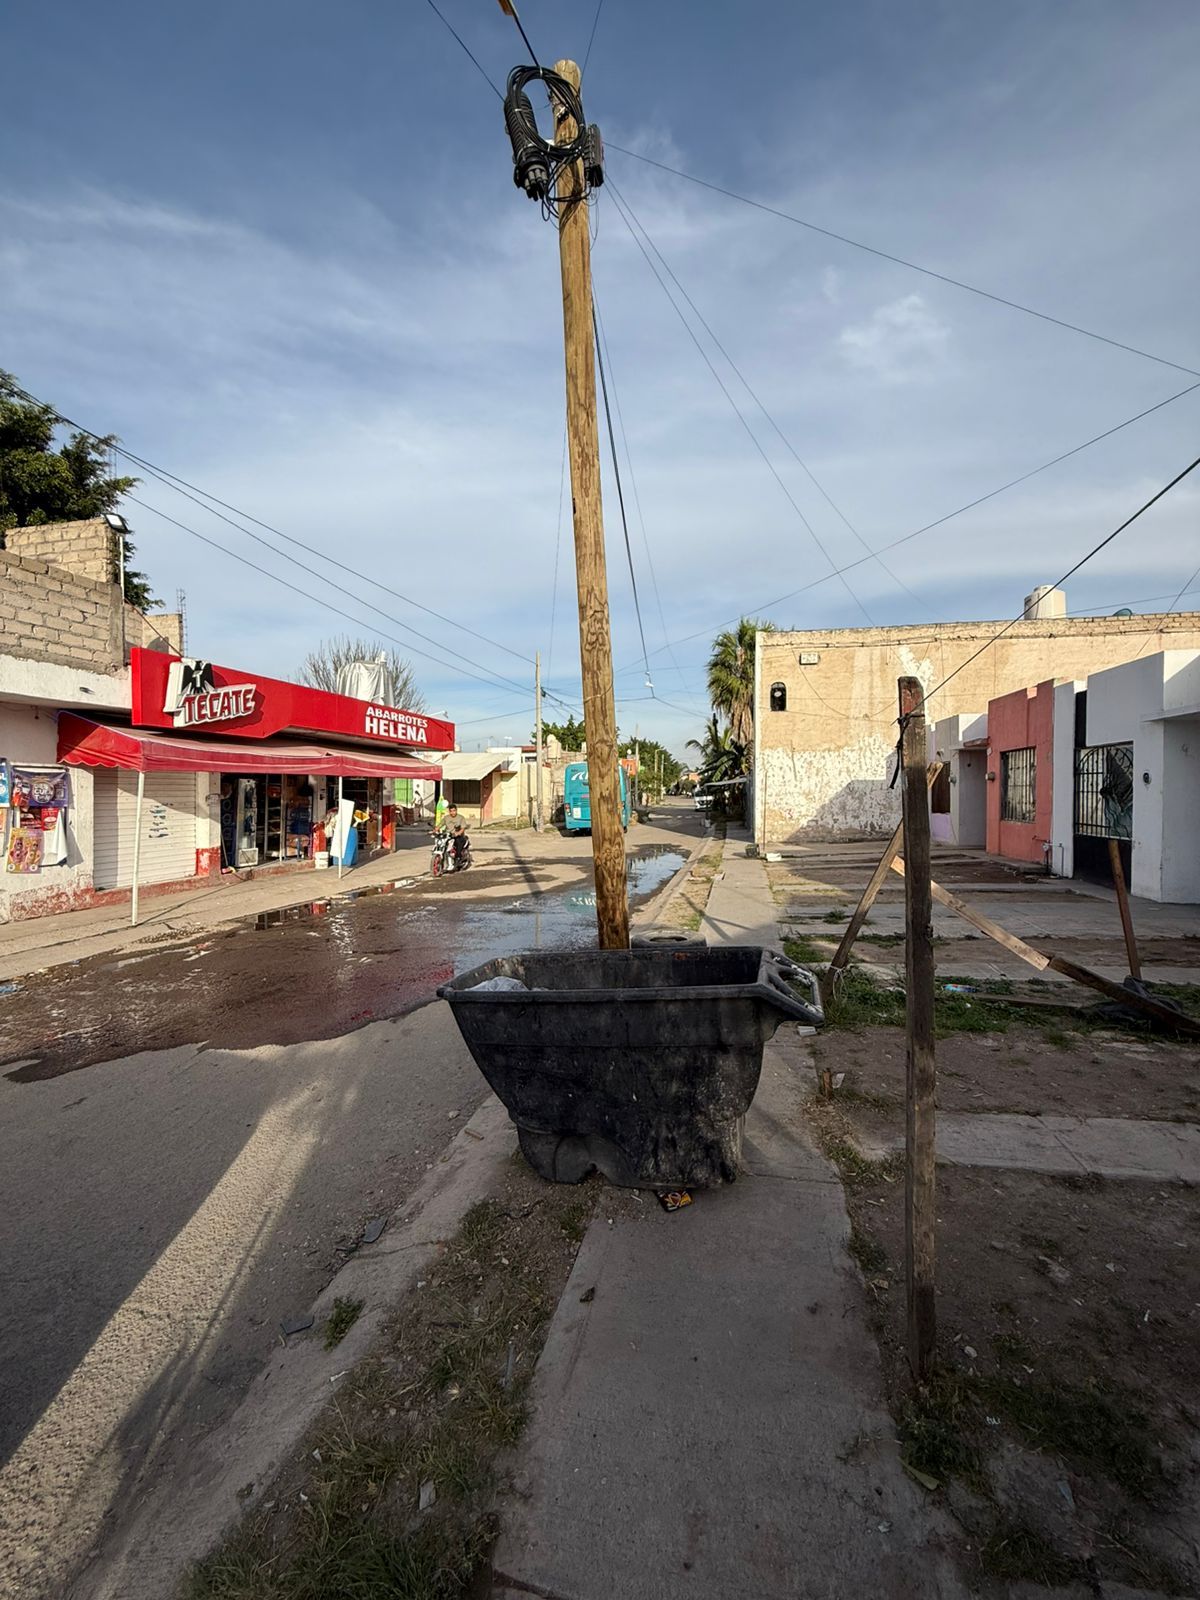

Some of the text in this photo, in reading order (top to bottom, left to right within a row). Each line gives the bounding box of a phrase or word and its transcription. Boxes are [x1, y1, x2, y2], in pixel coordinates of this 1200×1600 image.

[184, 687, 255, 725] TECATE
[366, 706, 428, 728] ABARROTES
[365, 716, 427, 744] HELENA
